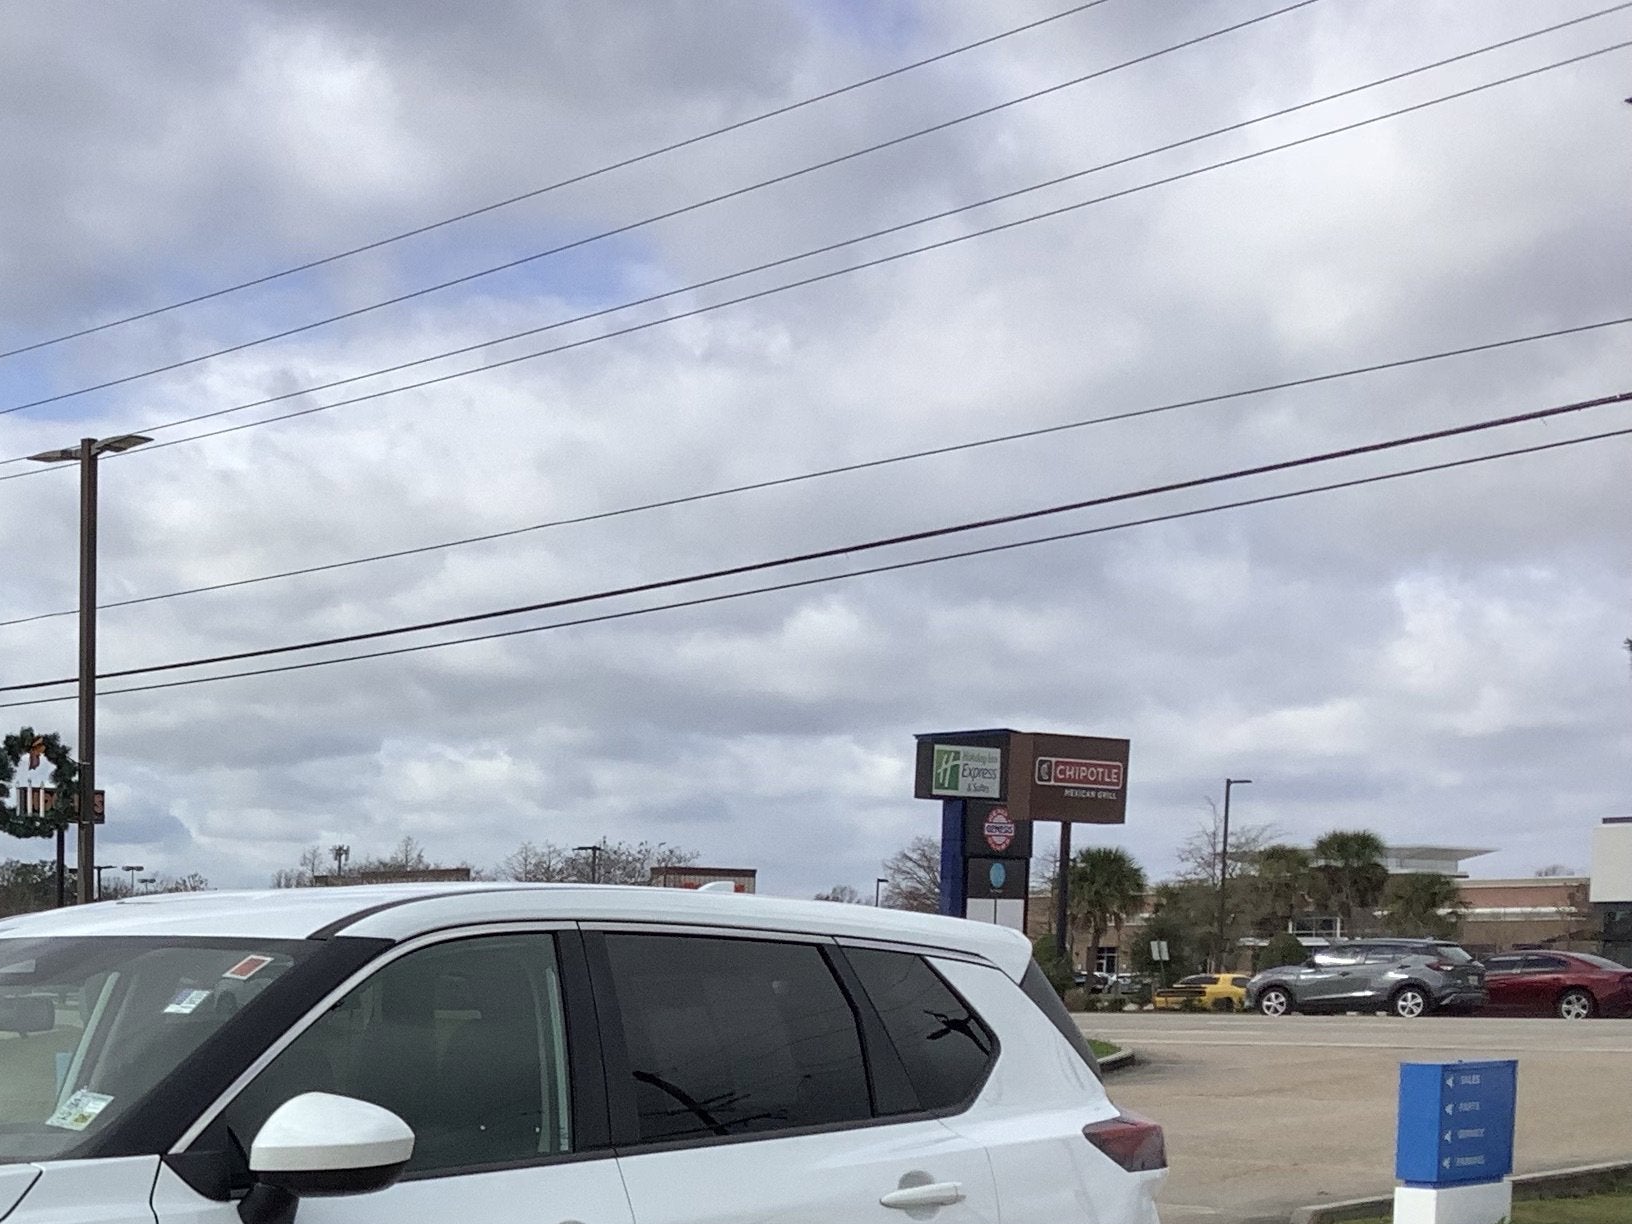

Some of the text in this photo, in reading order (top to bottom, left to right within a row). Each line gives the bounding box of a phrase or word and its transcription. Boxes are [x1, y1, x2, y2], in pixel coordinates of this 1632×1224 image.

[961, 763, 998, 782] Express
[1056, 765, 1119, 782] CHIPOTLE
[1064, 789, 1117, 800] MEXICAN GRILL
